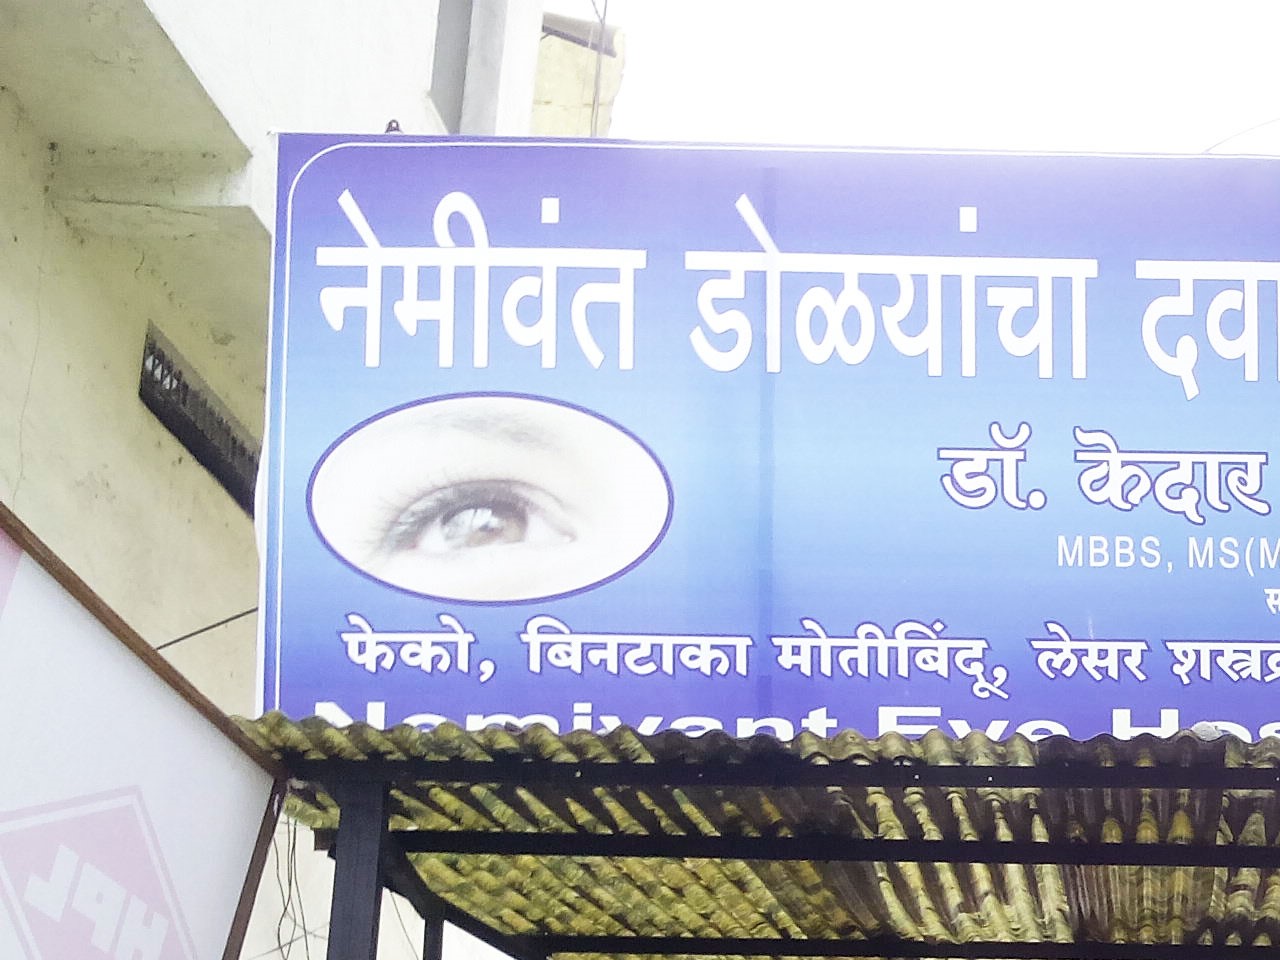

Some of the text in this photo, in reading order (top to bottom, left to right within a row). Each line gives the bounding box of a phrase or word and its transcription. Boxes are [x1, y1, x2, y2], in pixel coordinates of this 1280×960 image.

[315, 188, 648, 371] नेमीवंत
[938, 421, 1047, 511] डॉ.
[1073, 425, 1272, 525] केदार
[1056, 534, 1173, 575] MBBS,
[340, 613, 496, 683] फेको,
[520, 615, 754, 678] बिनटाका
[771, 617, 1009, 699] मोतीबिंदू,
[1030, 621, 1151, 684] लेसर
